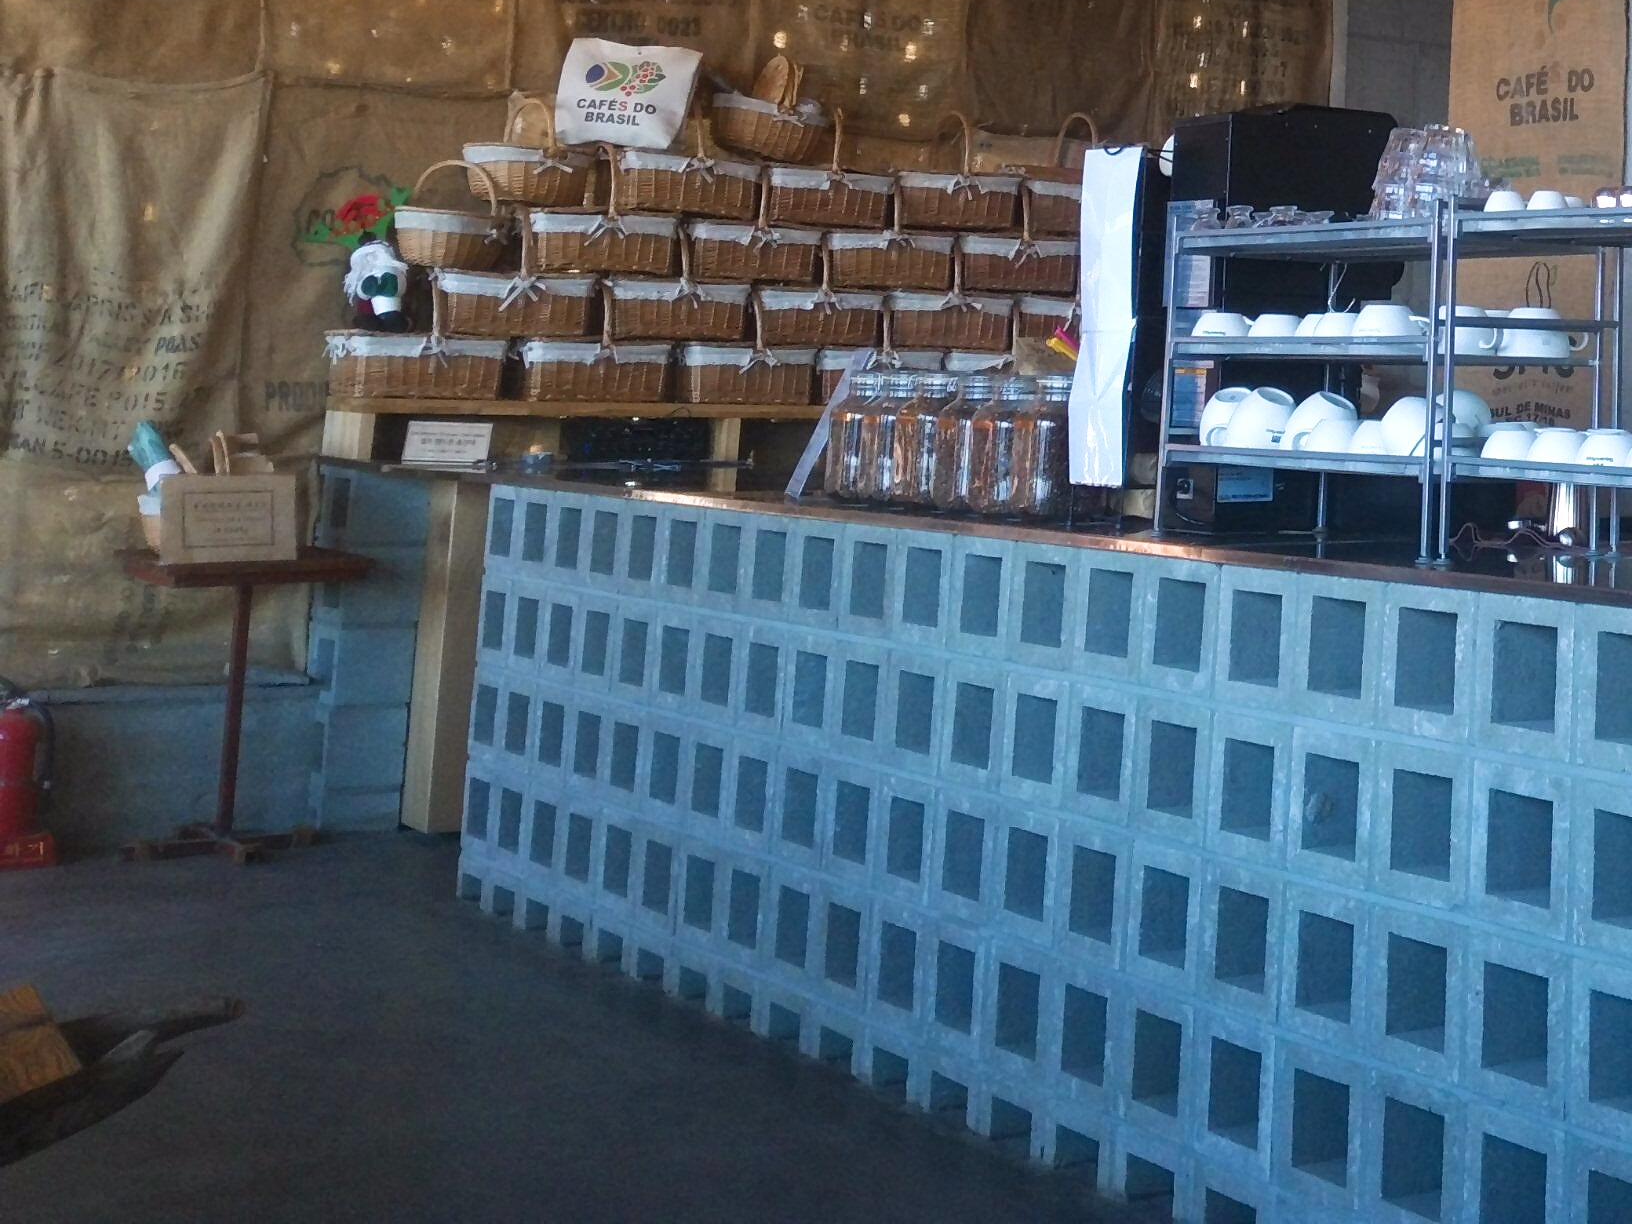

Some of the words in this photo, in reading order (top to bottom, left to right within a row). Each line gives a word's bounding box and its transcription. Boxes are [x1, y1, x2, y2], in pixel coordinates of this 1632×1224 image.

[1567, 67, 1595, 93] DO
[576, 97, 628, 112] CAFÉS
[633, 102, 657, 115] DO
[1510, 96, 1579, 127] BRASIL
[584, 111, 640, 127] BRASIL
[1516, 400, 1531, 415] DE
[1534, 400, 1571, 420] MINAS
